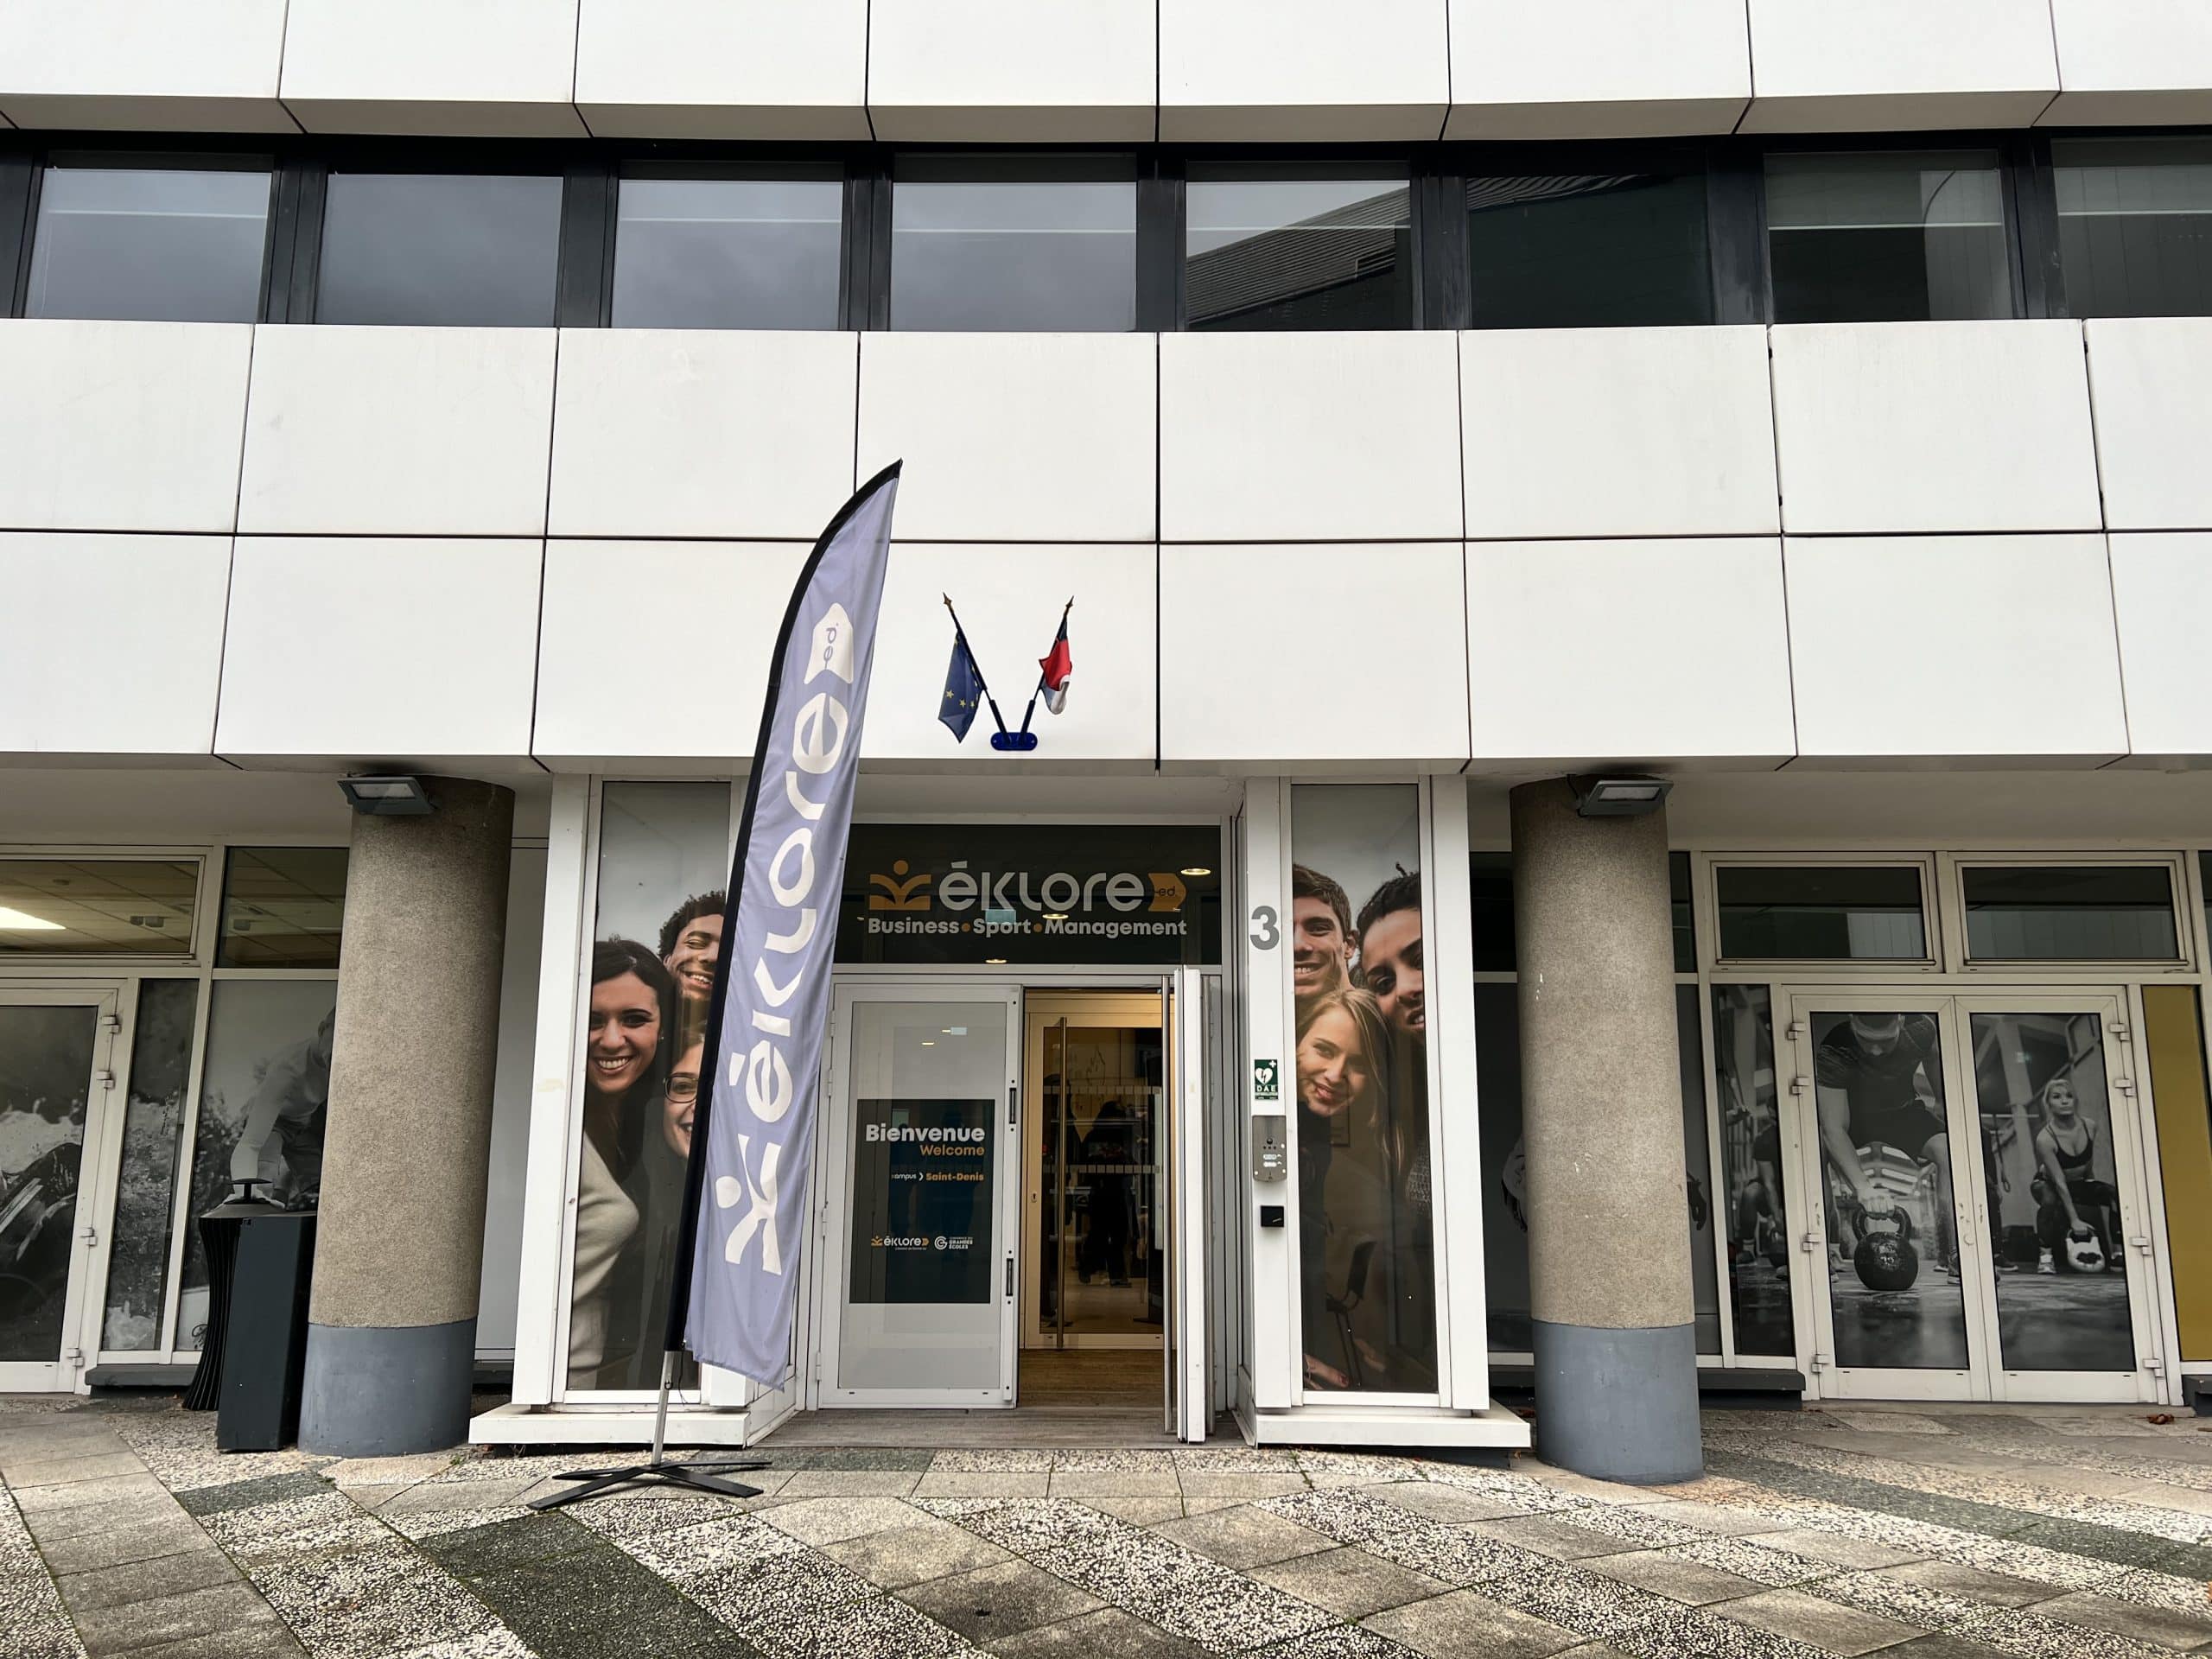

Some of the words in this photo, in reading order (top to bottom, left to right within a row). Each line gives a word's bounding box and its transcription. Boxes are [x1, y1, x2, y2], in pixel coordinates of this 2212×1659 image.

[868, 918, 959, 935] Business
[973, 918, 1032, 938] Sport
[1044, 918, 1187, 939] Management
[1249, 906, 1280, 950] 3
[866, 1123, 986, 1141] Bienvenue
[919, 1144, 985, 1156] Welcome
[925, 1172, 984, 1181] Saint-Denis
